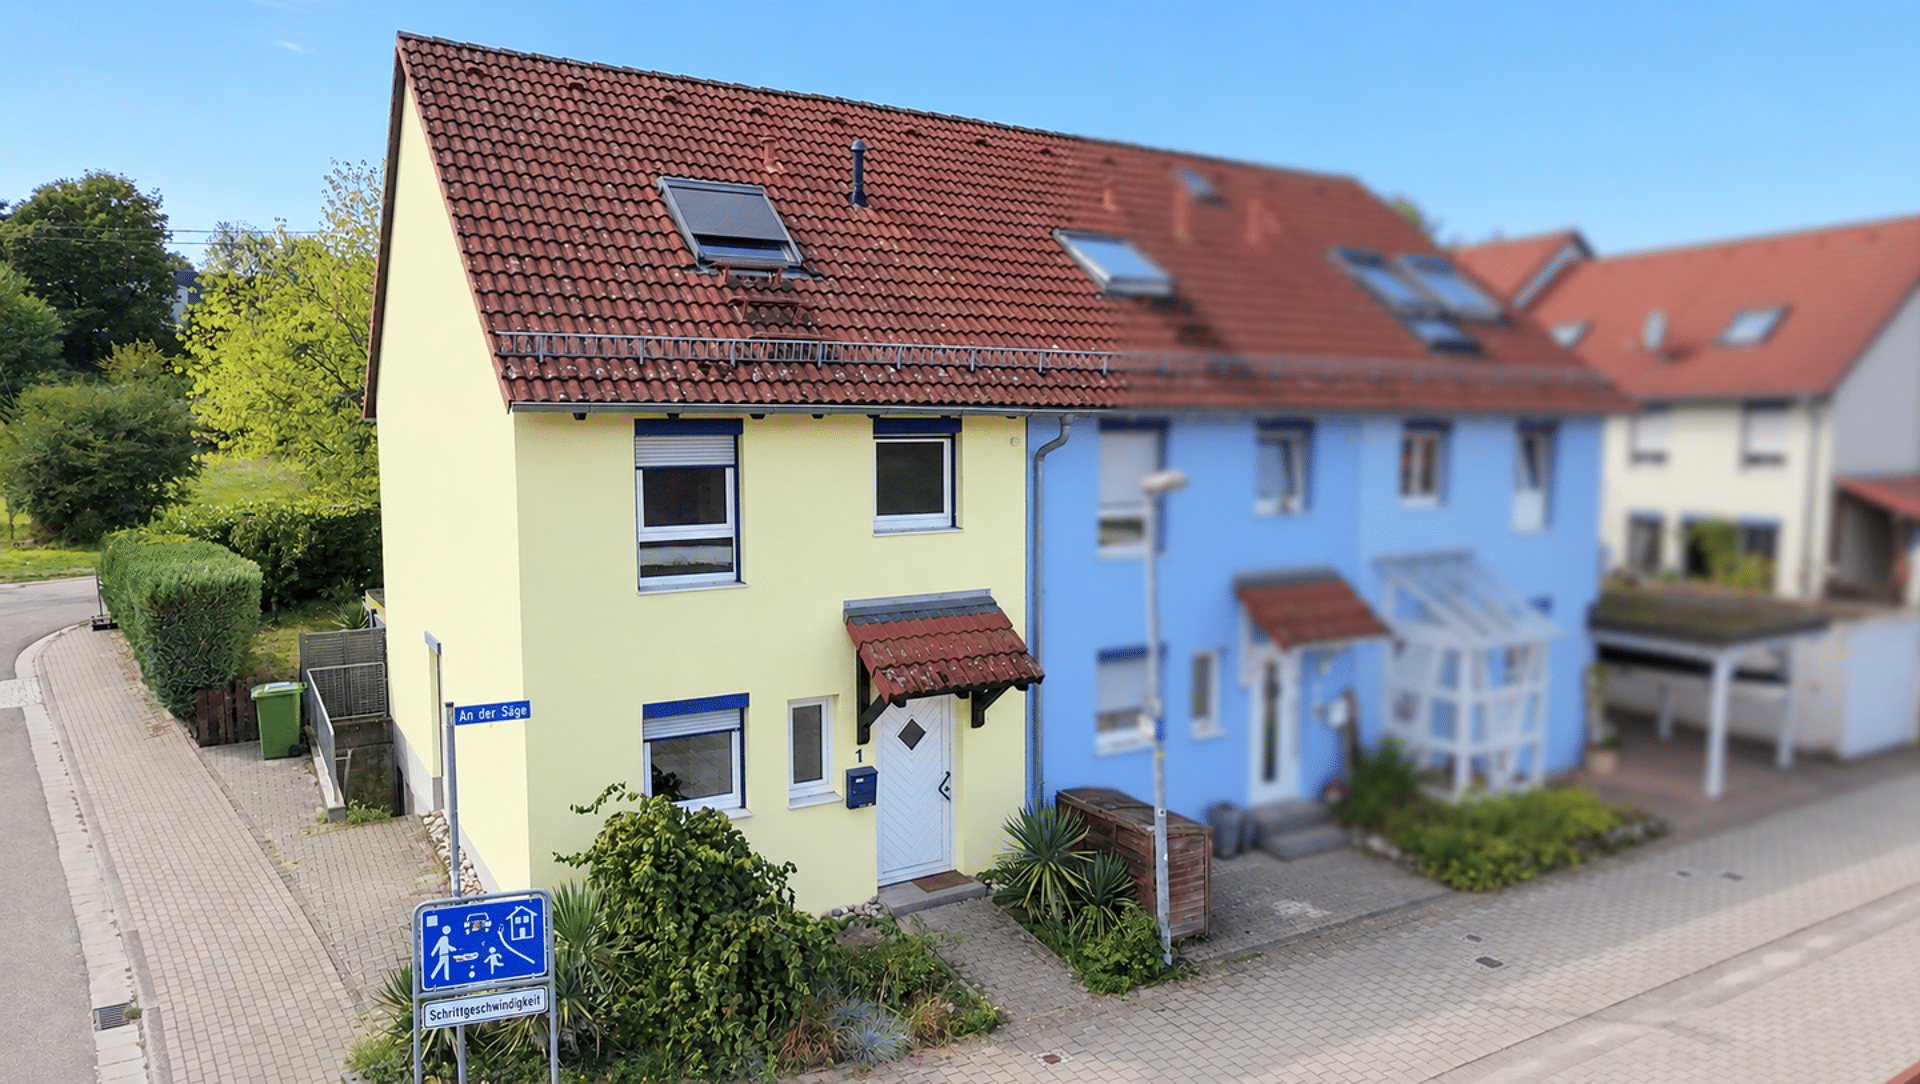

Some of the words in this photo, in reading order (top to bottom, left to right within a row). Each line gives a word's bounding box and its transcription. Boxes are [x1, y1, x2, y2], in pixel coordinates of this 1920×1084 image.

[459, 710, 474, 721] An
[478, 707, 496, 720] der
[855, 748, 863, 763] 1
[429, 994, 541, 1021] Schrittgeschwindigkeit
